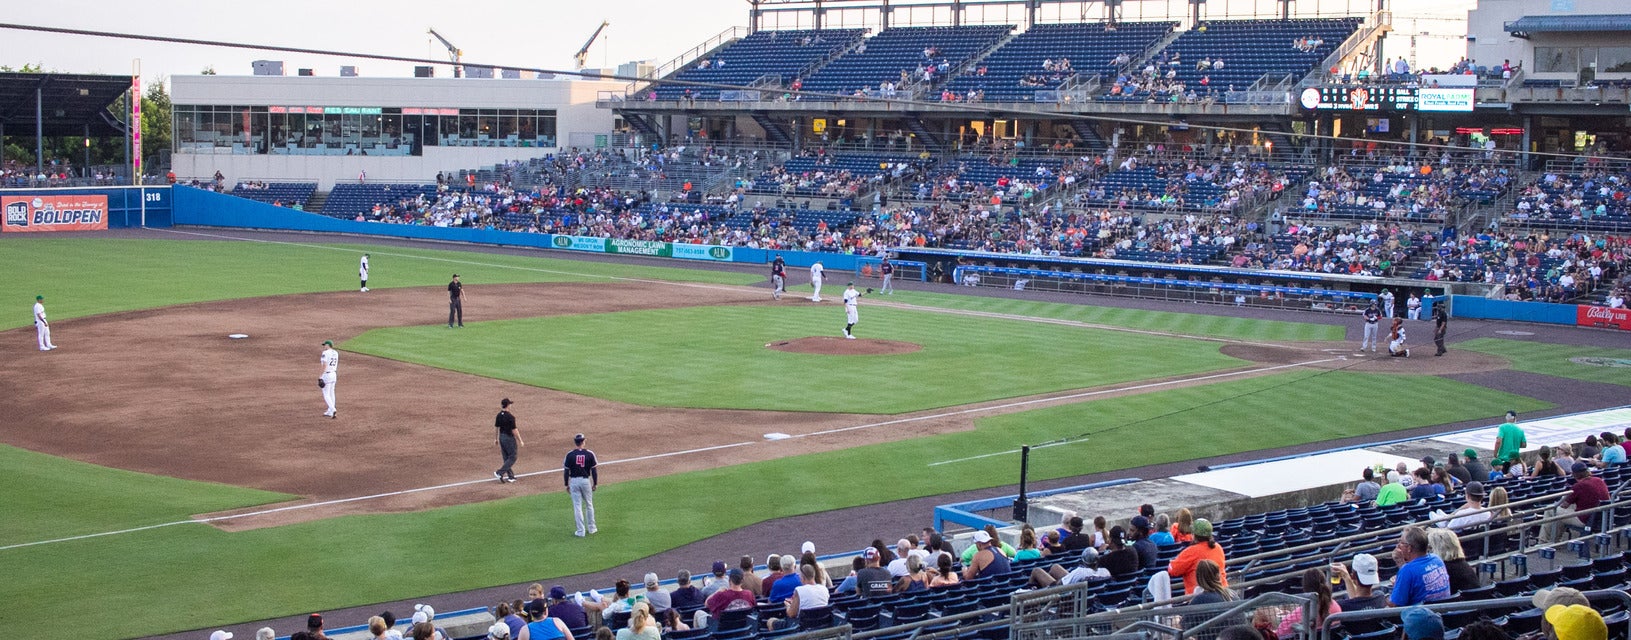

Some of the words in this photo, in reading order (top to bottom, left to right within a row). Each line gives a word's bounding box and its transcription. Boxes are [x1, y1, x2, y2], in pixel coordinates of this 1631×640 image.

[146, 192, 161, 201] 318
[8, 206, 26, 214] BOLD
[8, 213, 27, 221] ROCK
[34, 209, 101, 224] BOLDPEN
[557, 236, 568, 246] ALM
[611, 239, 647, 249] AGRONOMIC
[648, 241, 666, 249] LAWN
[617, 246, 659, 255] MANAGEMENT
[713, 248, 725, 258] ALM
[1587, 306, 1614, 322] Bally
[329, 357, 337, 367] 23
[576, 454, 585, 468] 4
